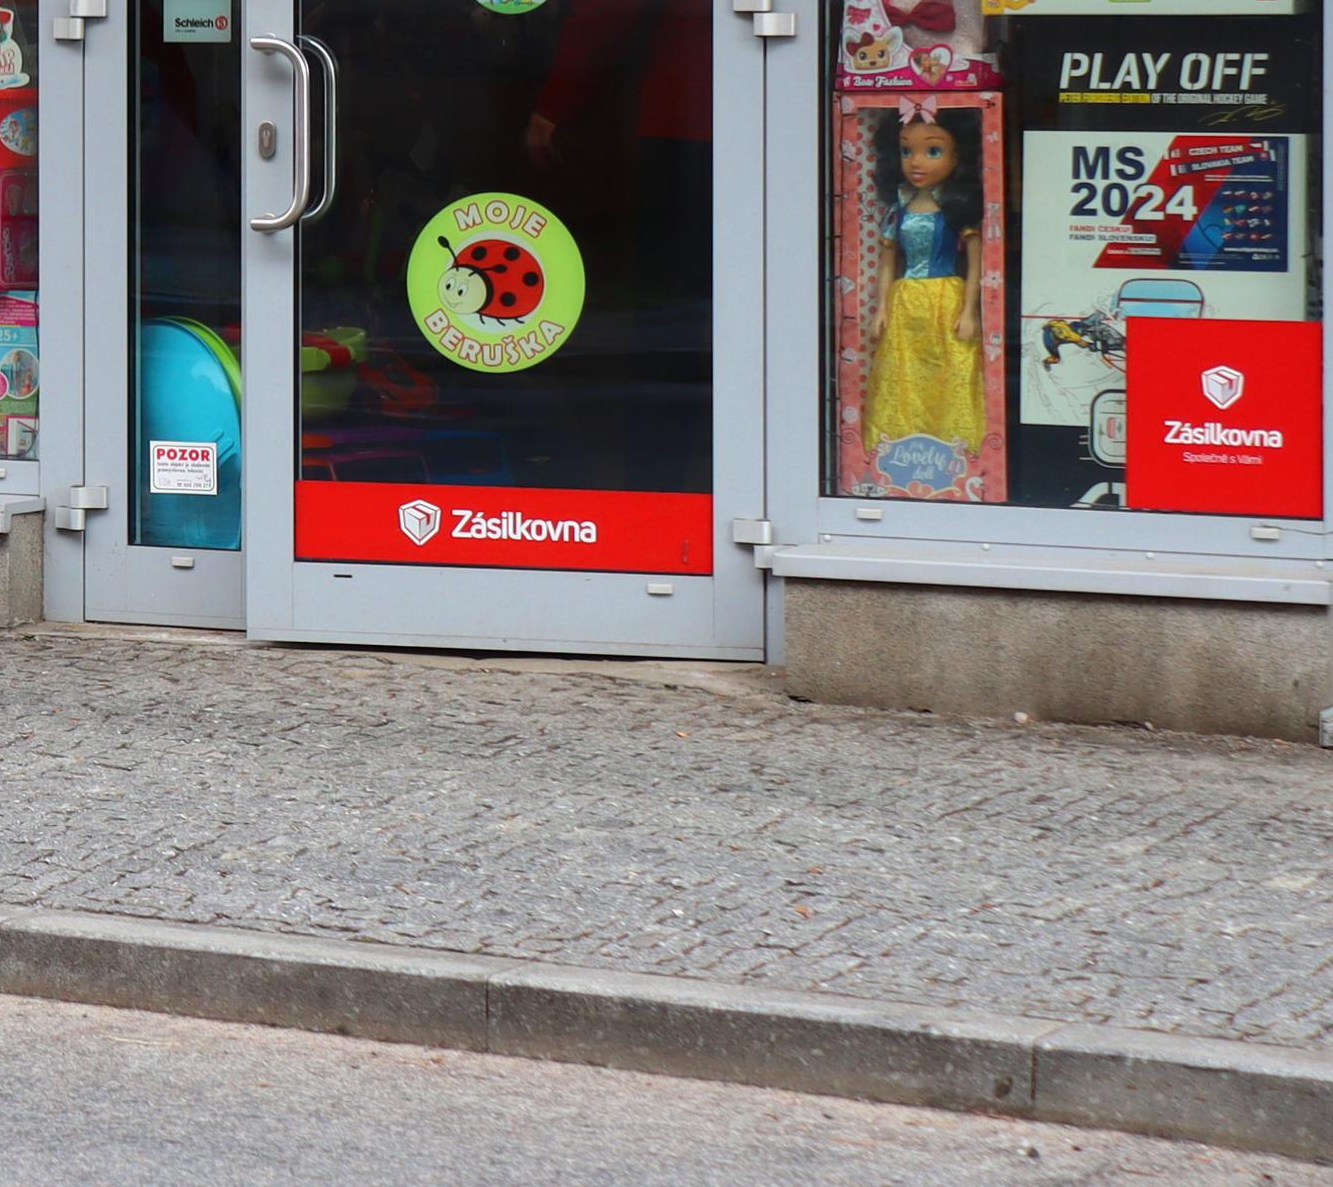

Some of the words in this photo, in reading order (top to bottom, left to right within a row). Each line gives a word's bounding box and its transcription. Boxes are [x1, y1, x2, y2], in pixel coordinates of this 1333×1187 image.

[175, 17, 214, 28] Schleich
[1059, 52, 1171, 90] PLAY
[1179, 52, 1270, 91] OFF
[1071, 145, 1146, 181] MS
[1219, 144, 1244, 154] TEAM
[1231, 155, 1255, 166] TEAM
[1069, 182, 1199, 221] 2024
[453, 200, 548, 239] MOJE
[424, 309, 565, 366] BERUŠKA
[1164, 420, 1284, 448] Zásilkovna
[156, 448, 210, 461] POZOR
[889, 445, 947, 471] Lovely
[1183, 451, 1228, 464] Společně
[1230, 455, 1236, 463] s
[1237, 454, 1262, 464] Vámi
[451, 509, 598, 544] Zásilkovna
